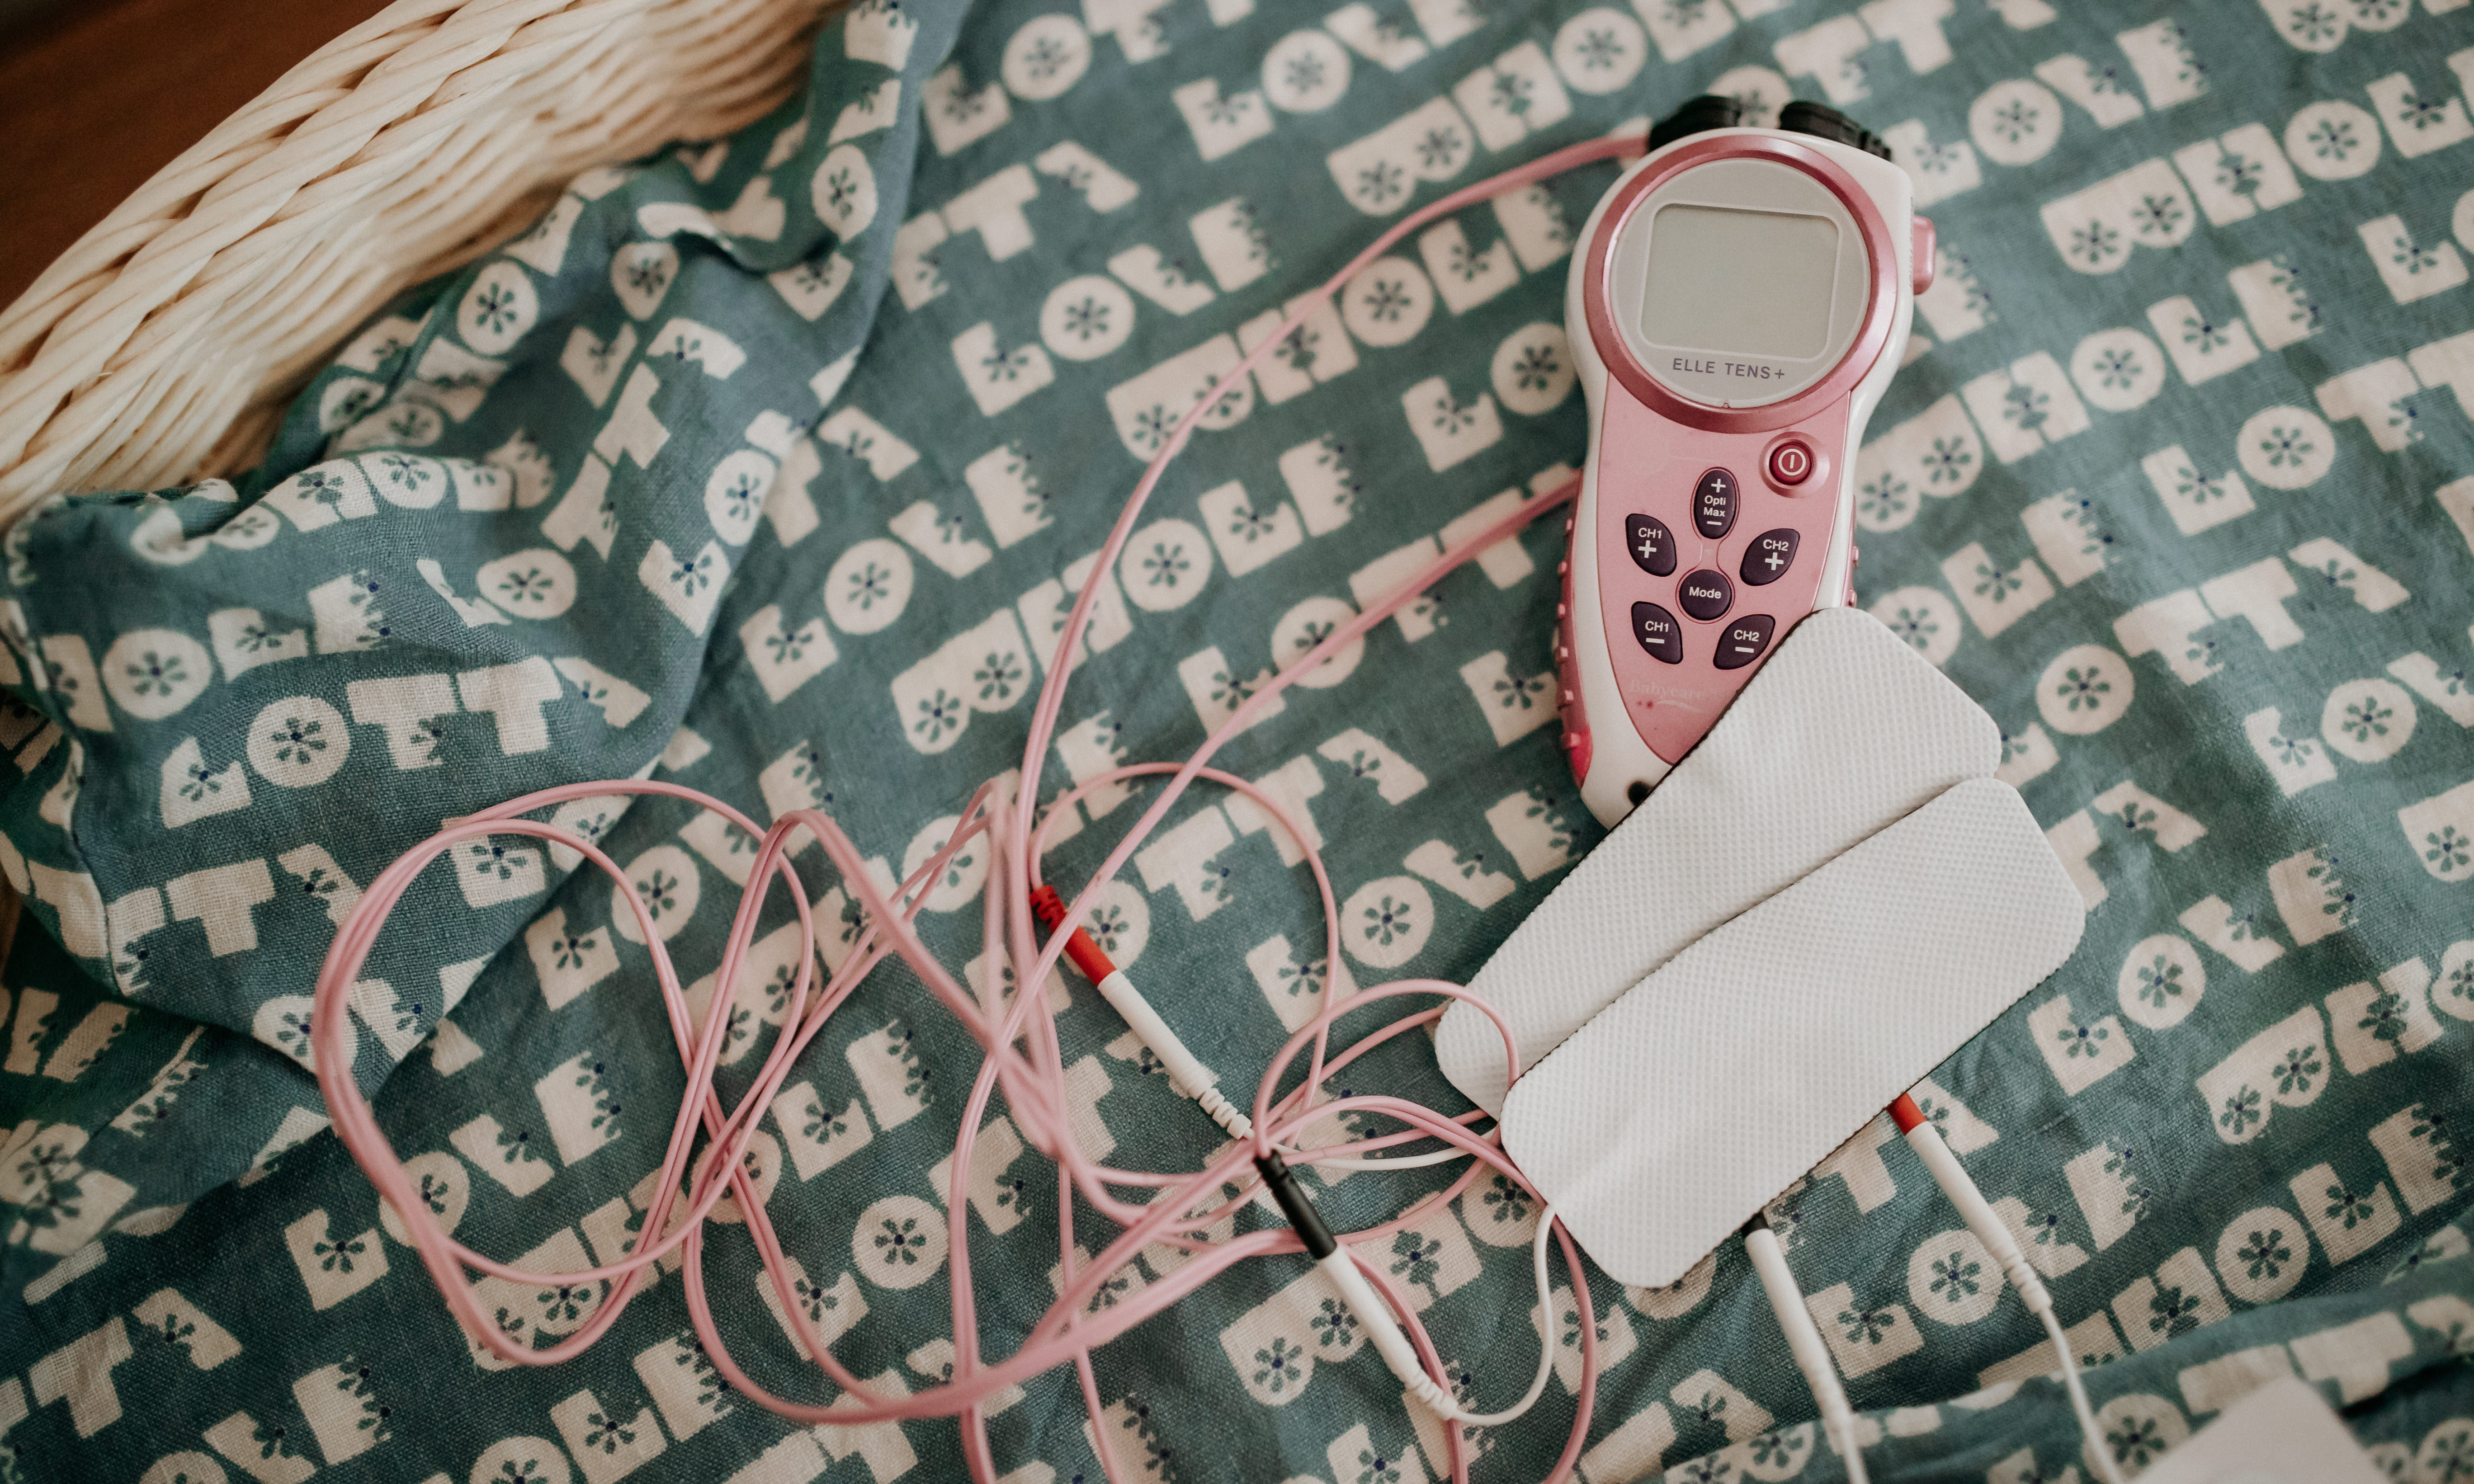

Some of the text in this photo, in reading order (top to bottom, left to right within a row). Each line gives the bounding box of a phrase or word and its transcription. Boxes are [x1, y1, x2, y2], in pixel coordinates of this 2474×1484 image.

[1673, 358, 1715, 374] ELLE
[1704, 495, 1726, 506] Opti
[1704, 507, 1726, 518] Max
[1638, 527, 1662, 539] CH1
[1763, 539, 1789, 551] CH2
[1689, 587, 1722, 599] Mode
[1645, 620, 1669, 632] CH1
[1734, 629, 1759, 642] CH2
